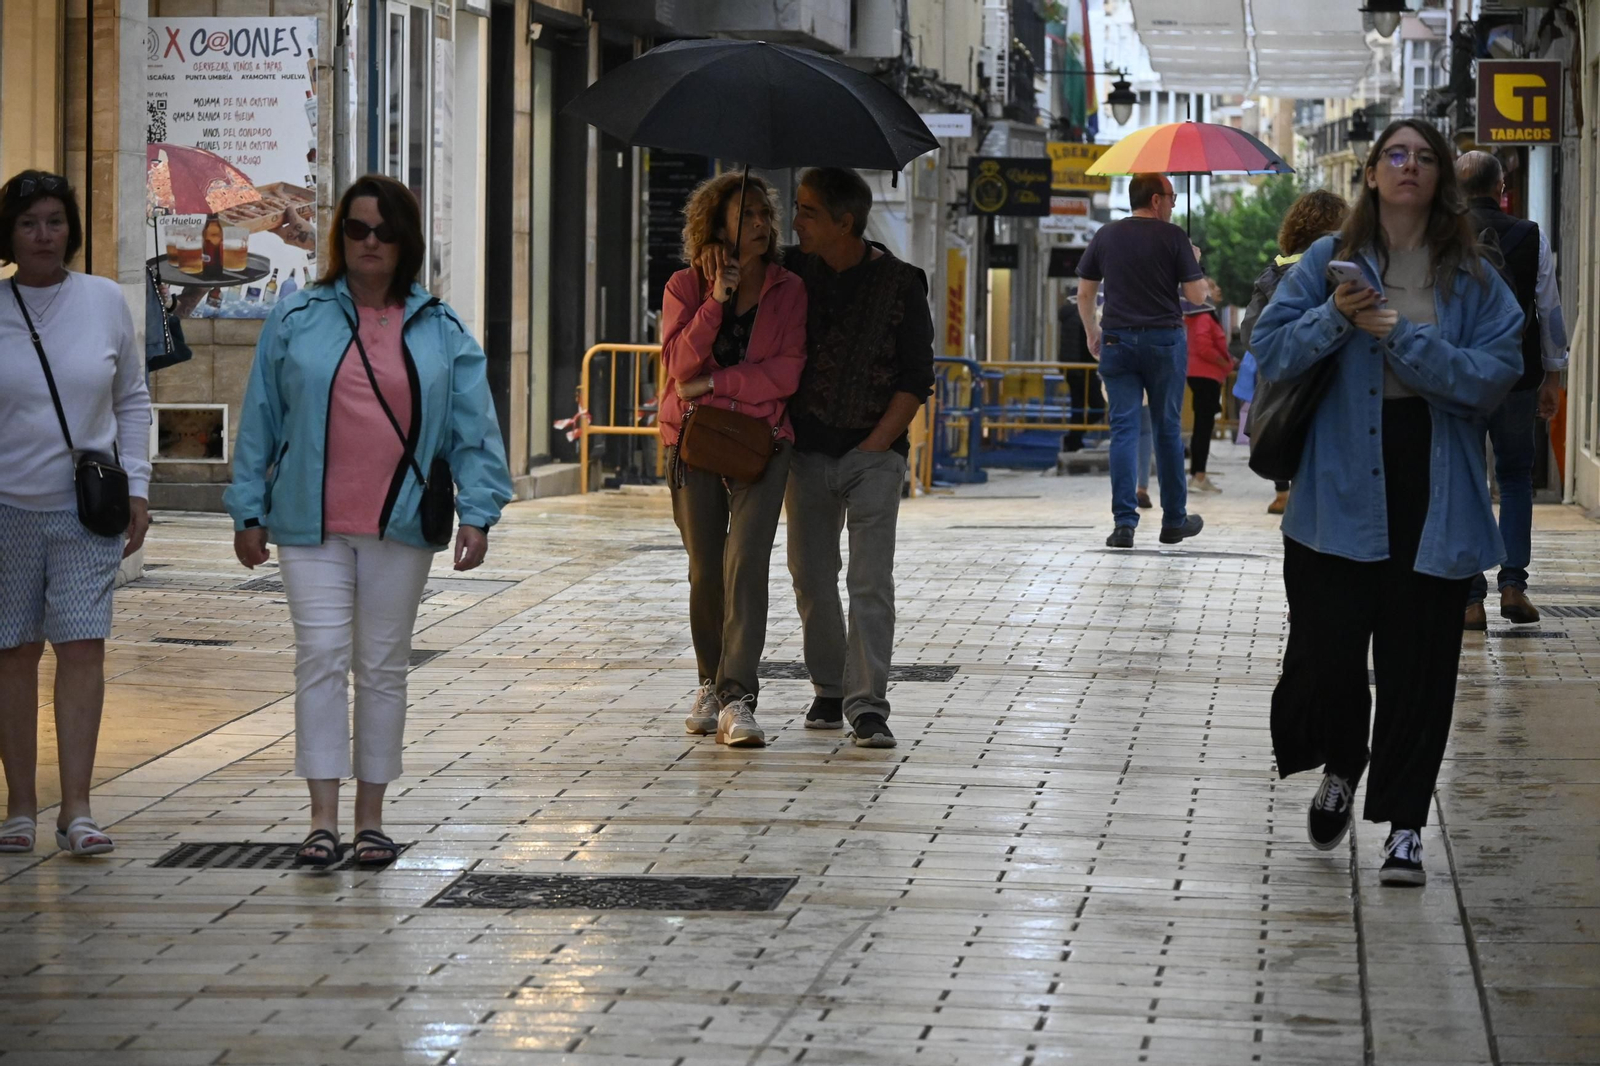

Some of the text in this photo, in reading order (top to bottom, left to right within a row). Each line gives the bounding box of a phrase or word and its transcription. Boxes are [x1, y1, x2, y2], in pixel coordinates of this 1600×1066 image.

[163, 26, 302, 63] X C@JONES
[193, 61, 231, 73] CERVEZAS,
[264, 60, 283, 73] TAPAS
[208, 72, 233, 80] UMBRÍA
[193, 97, 220, 108] MOJAMA
[223, 97, 233, 107] DE
[197, 111, 220, 122] BLANCA
[223, 112, 232, 121] DE
[202, 127, 273, 138] VINOS DEL CONDADO
[1490, 127, 1551, 140] TABACOS
[223, 141, 233, 150] DE
[159, 216, 203, 226] de Huelva
[948, 285, 963, 347] DHL
